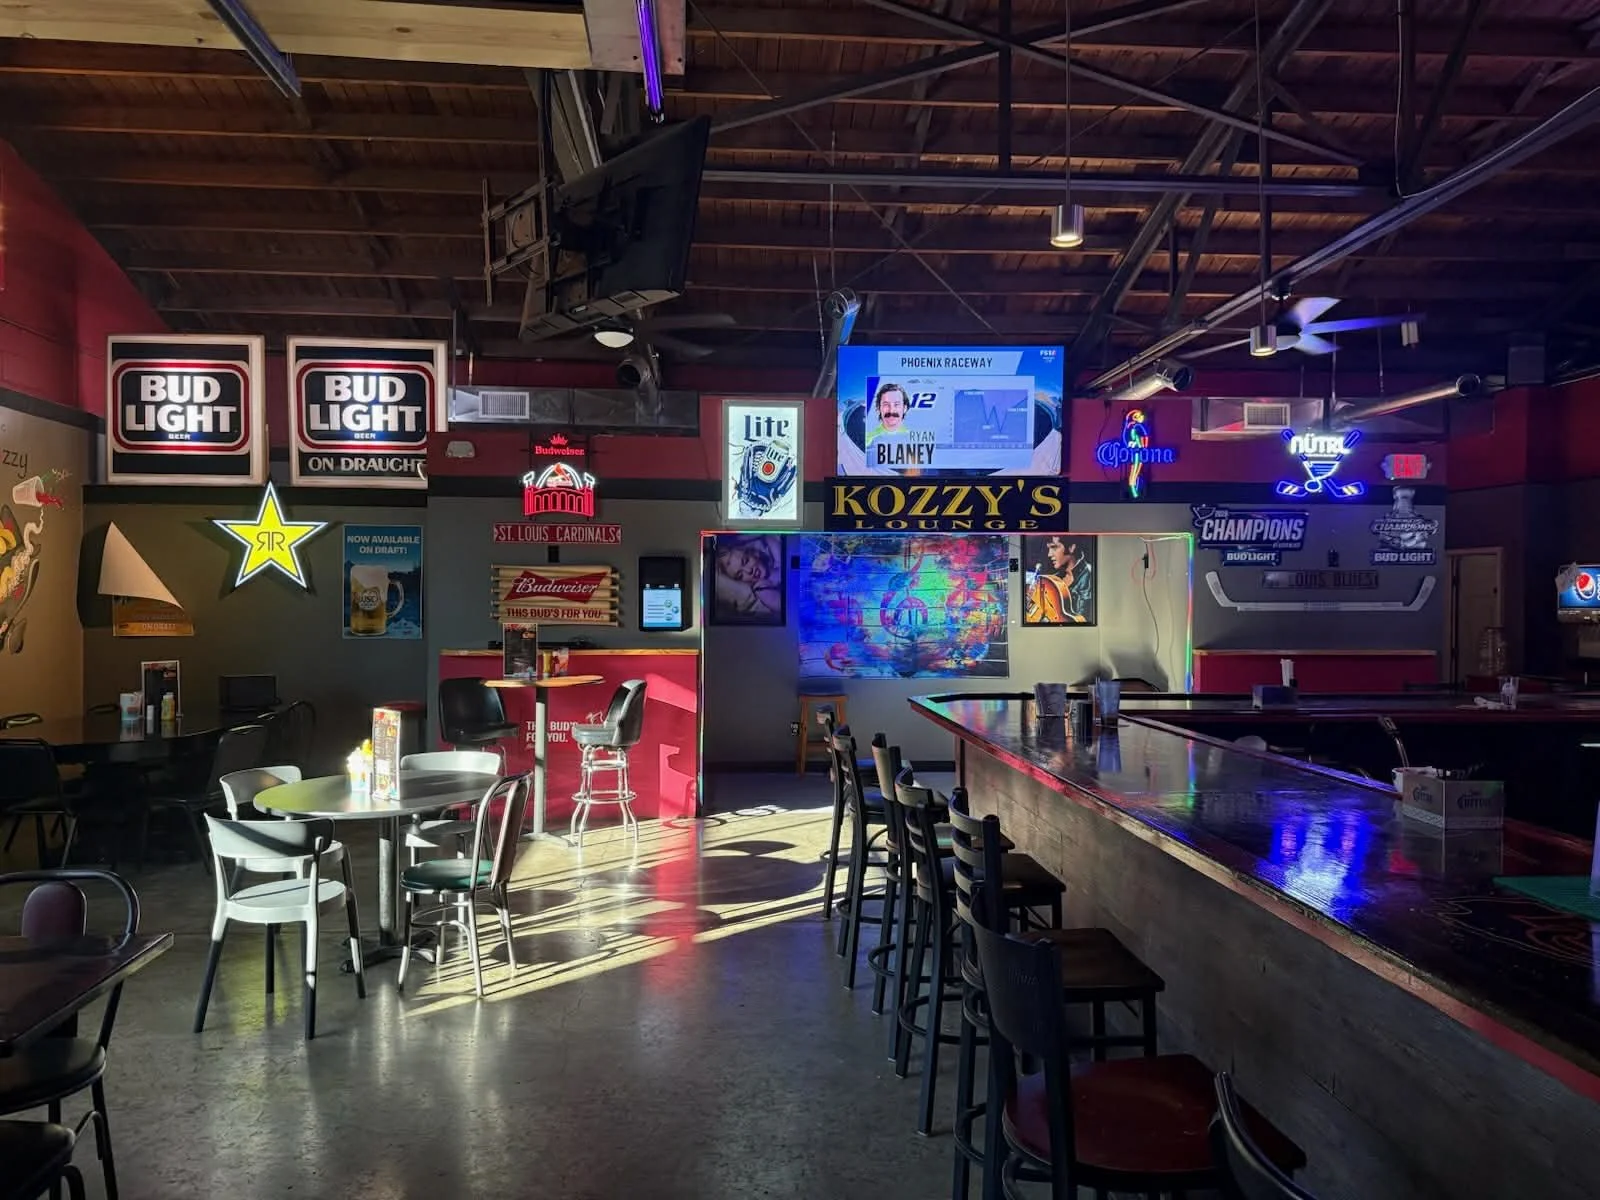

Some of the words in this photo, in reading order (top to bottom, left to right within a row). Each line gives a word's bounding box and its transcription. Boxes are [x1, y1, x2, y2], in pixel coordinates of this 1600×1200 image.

[901, 358, 942, 368] PHOENIX
[944, 358, 992, 368] RACEWAY
[140, 375, 222, 403] BUD
[325, 375, 406, 403] BUD
[911, 393, 936, 408] 12
[125, 404, 237, 432] LIGHT
[309, 404, 421, 432] LIGHT
[744, 415, 789, 442] Lite
[910, 431, 935, 441] RYAN
[535, 446, 584, 455] Budweiser
[877, 444, 934, 464] BLANEY
[1097, 441, 1174, 468] Corona
[2, 449, 28, 479] zzy
[308, 457, 334, 472] ON
[832, 479, 1063, 517] KOZZY'S
[855, 520, 1040, 530] LOUNGE
[1202, 519, 1304, 541] CHAMPIONS
[347, 535, 370, 544] NOW
[371, 535, 420, 544] AVAILABLE
[499, 526, 515, 541] ST.
[520, 526, 549, 541] LOUIS
[556, 526, 617, 542] CARDINALS
[360, 546, 373, 554] ON
[375, 546, 408, 554] DRAFT!
[1226, 552, 1247, 561] BUD
[1248, 552, 1276, 561] LIGHT
[1374, 552, 1398, 561] BUD
[1400, 552, 1432, 561] LIGHT
[511, 577, 598, 593] Budweiser
[506, 607, 528, 617] THIS
[530, 608, 560, 618] BUD'S
[561, 609, 580, 618] FOR
[547, 732, 568, 742] YOU.
